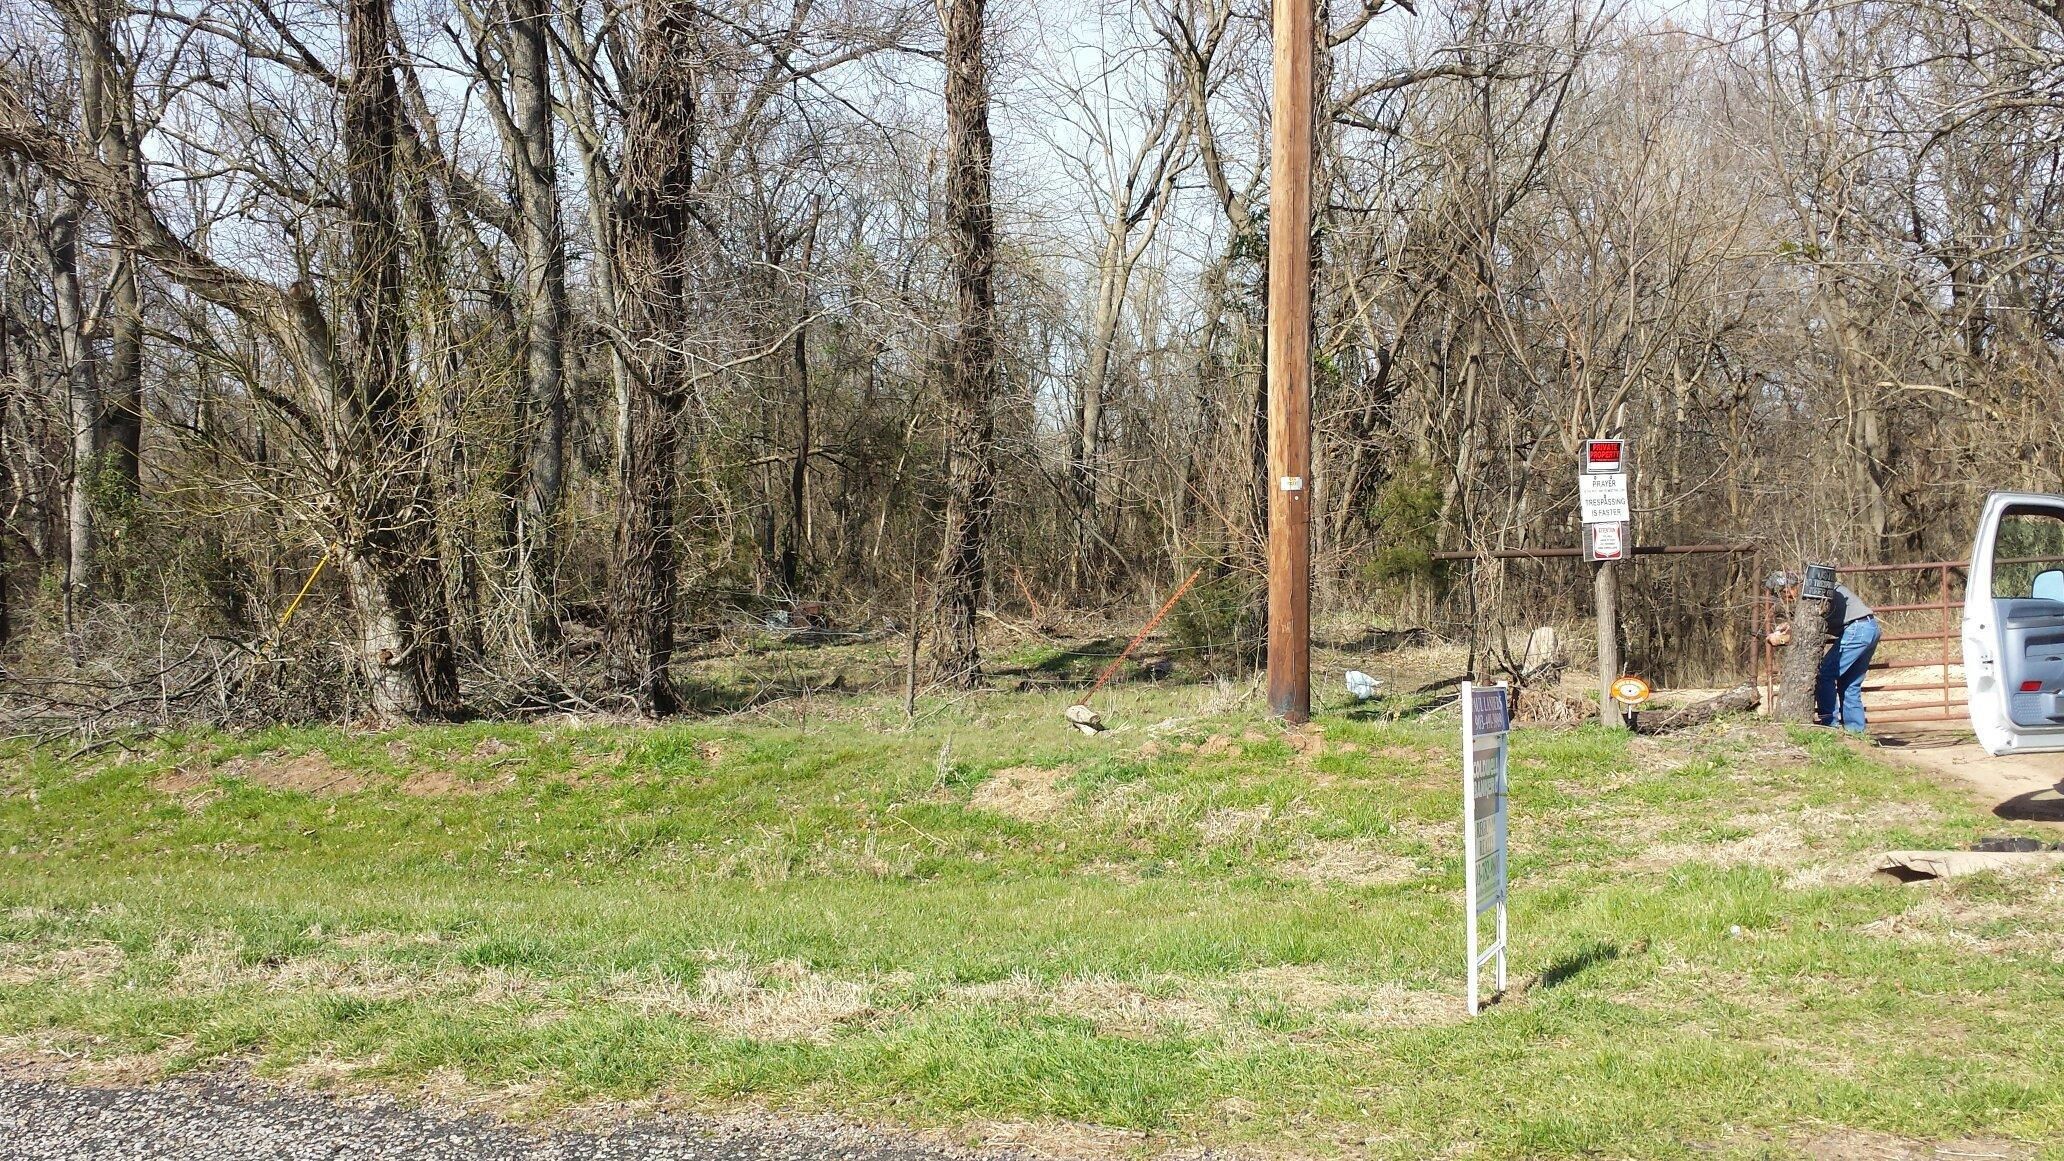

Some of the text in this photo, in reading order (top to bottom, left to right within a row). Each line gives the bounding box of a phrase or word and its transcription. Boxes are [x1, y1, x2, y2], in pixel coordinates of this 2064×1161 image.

[1592, 443, 1618, 451] PRIVATE
[1590, 450, 1619, 459] PROPERTY
[1585, 498, 1626, 506] TRESPASSING
